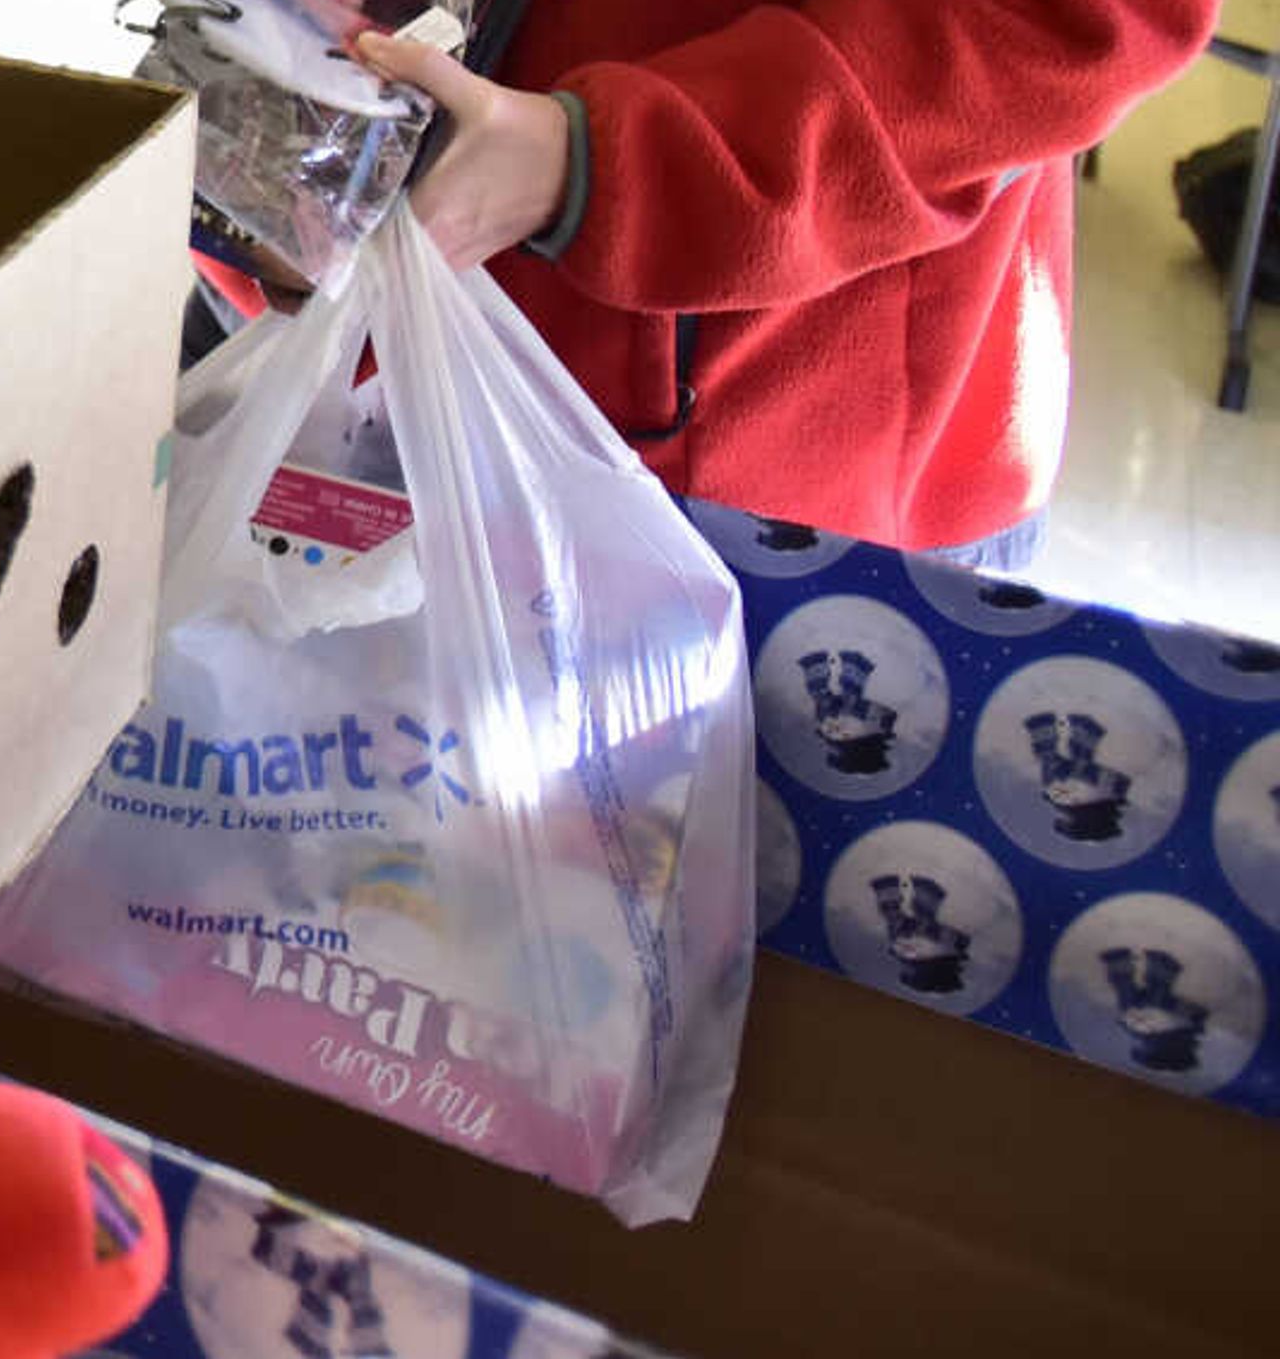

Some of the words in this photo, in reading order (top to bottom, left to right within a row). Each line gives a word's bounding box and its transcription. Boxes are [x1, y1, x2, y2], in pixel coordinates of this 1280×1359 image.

[110, 713, 377, 798] almart
[220, 808, 282, 833] Live
[289, 806, 387, 833] better.
[127, 901, 349, 952] walmart.com
